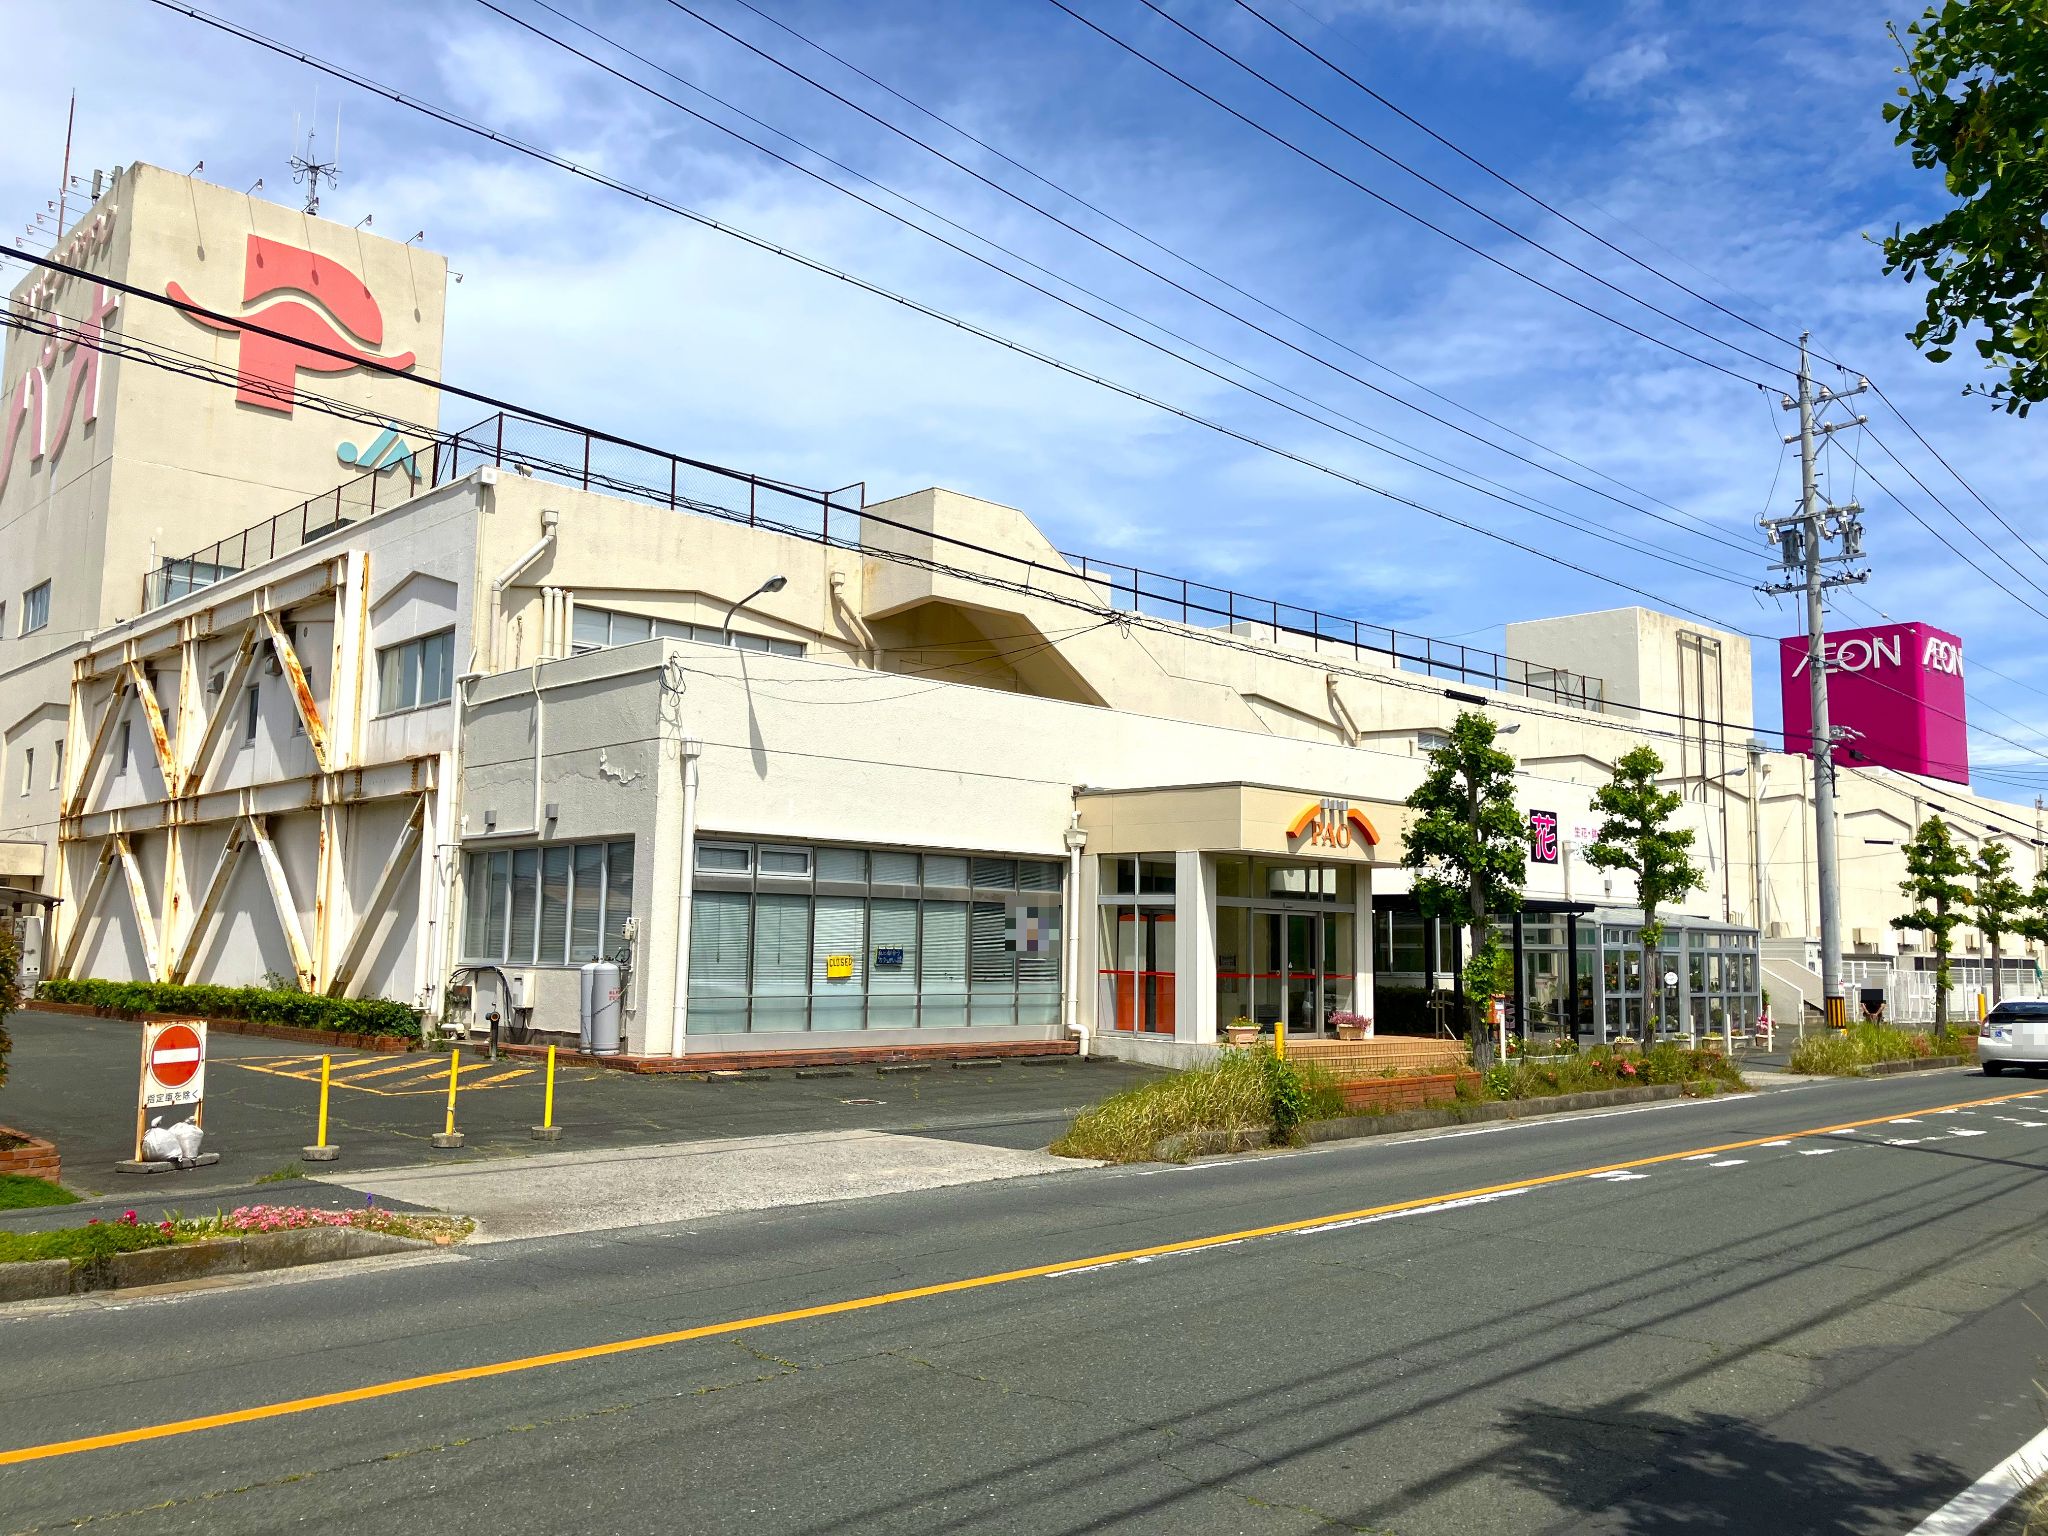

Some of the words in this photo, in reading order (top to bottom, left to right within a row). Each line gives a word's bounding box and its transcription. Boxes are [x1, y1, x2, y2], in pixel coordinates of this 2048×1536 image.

[1311, 818, 1352, 849] PAO
[1531, 813, 1556, 861] 花
[829, 957, 853, 967] CLOSED
[147, 1089, 198, 1104] 指定車を除く
